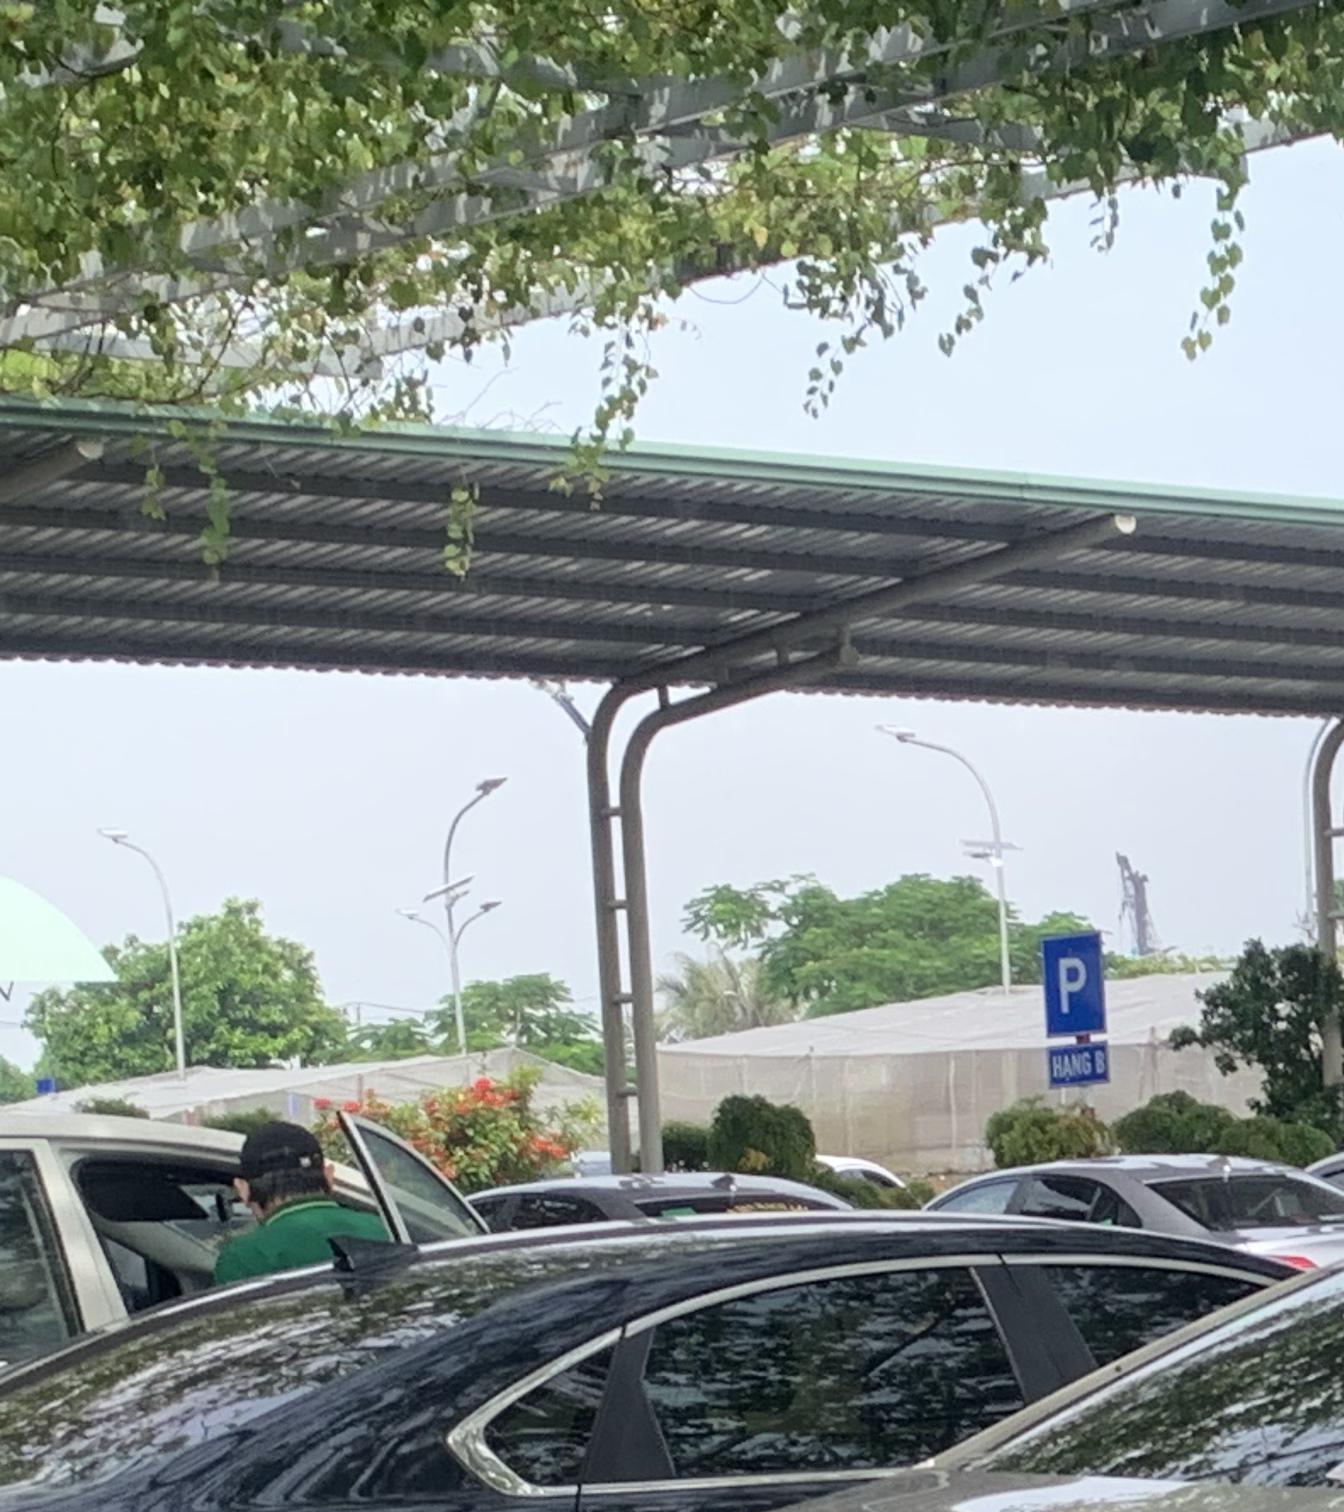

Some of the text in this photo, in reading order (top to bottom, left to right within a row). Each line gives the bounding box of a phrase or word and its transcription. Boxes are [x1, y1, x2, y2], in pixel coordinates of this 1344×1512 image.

[1058, 957, 1087, 1014] P
[1052, 1050, 1105, 1081] HẠNG B
